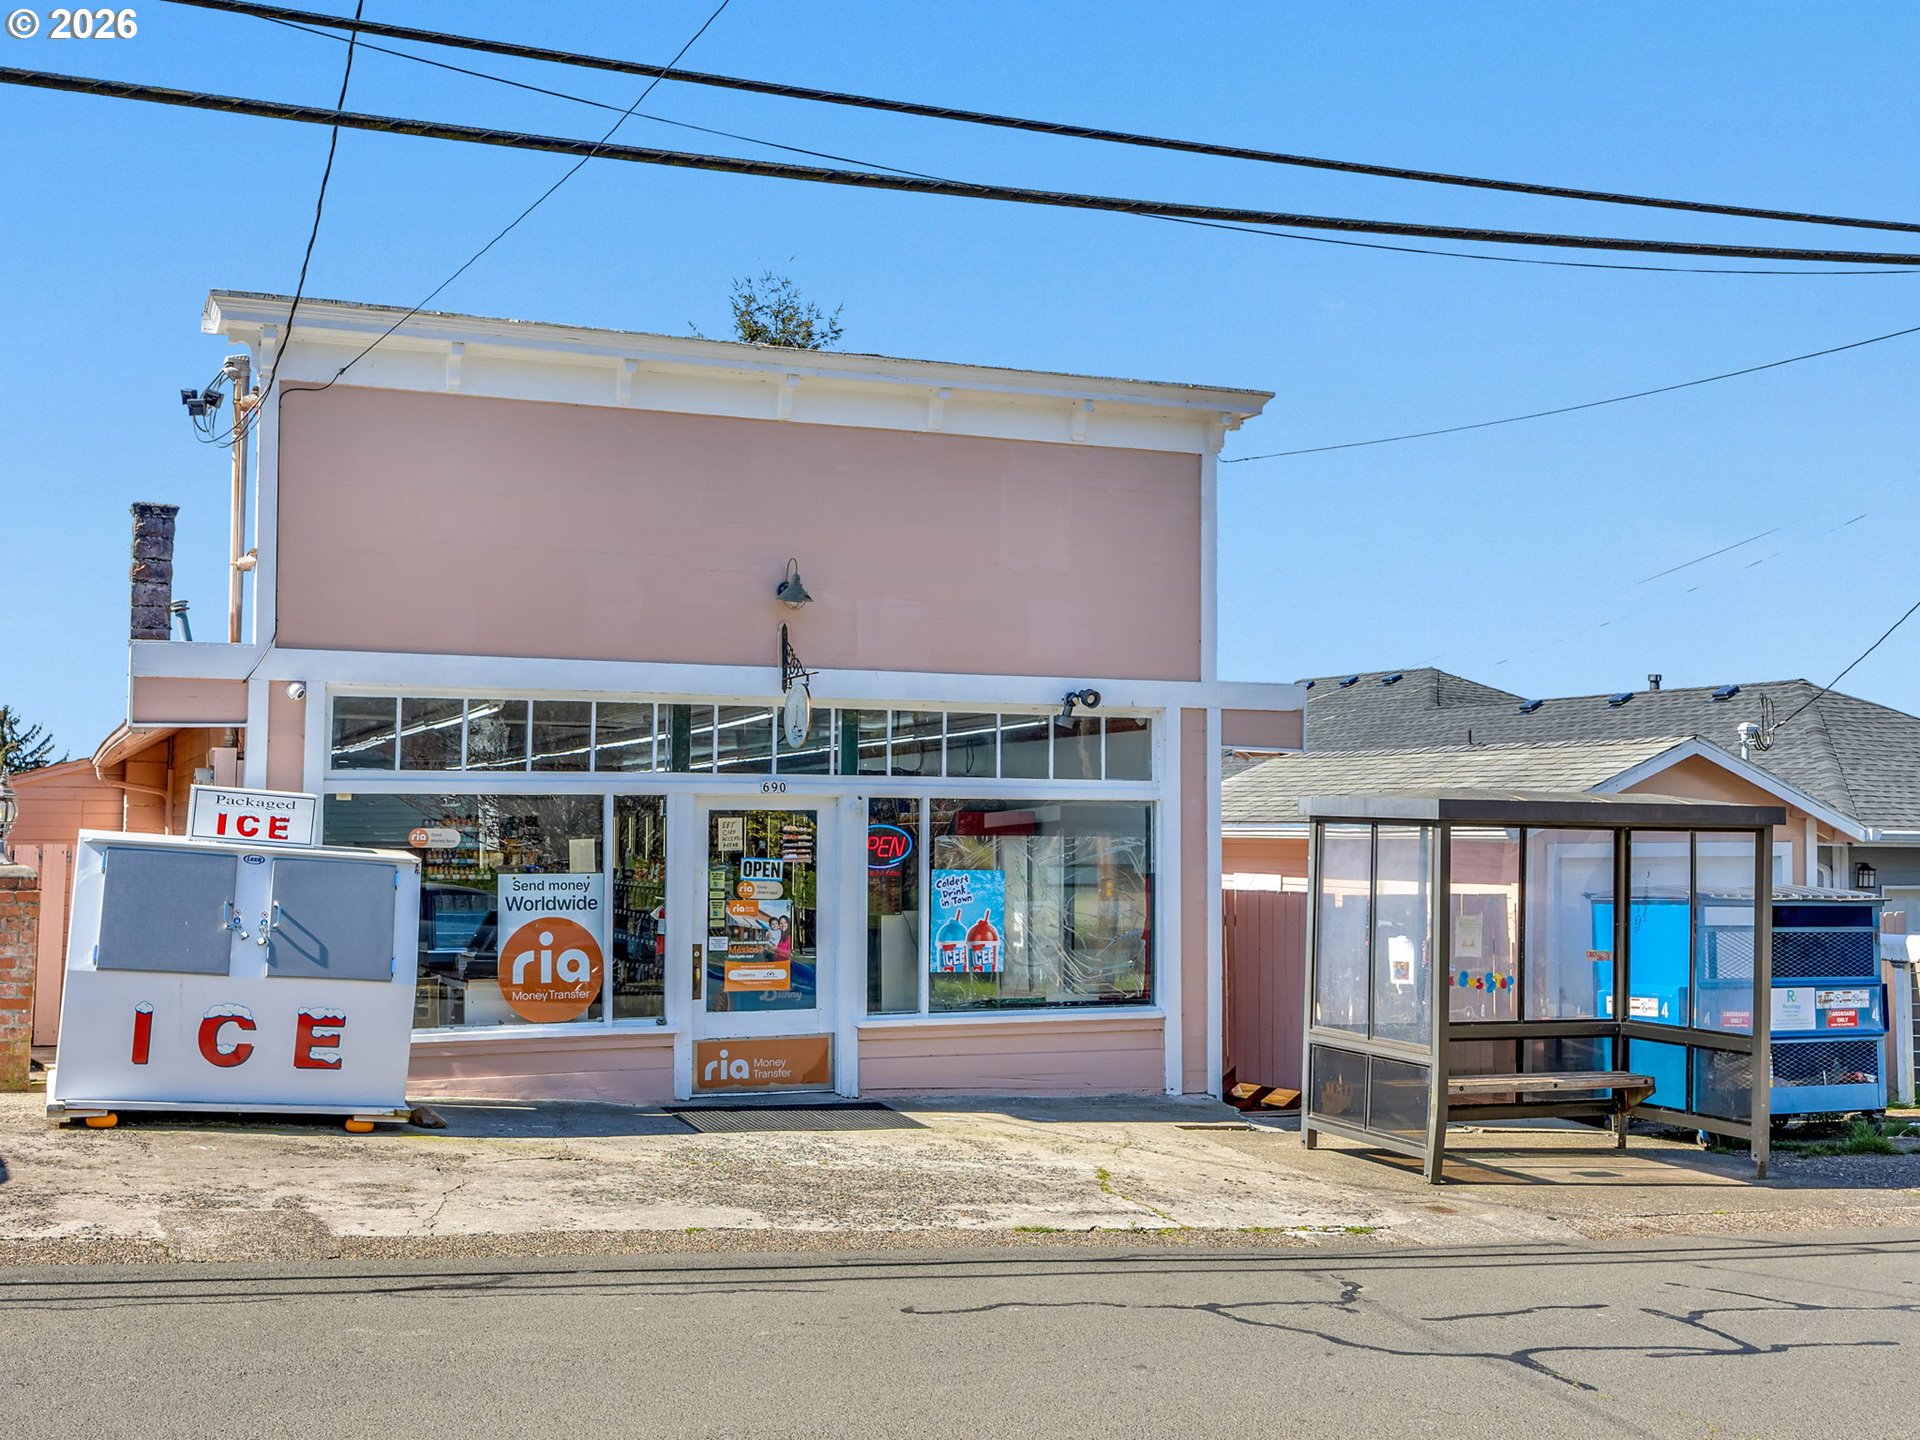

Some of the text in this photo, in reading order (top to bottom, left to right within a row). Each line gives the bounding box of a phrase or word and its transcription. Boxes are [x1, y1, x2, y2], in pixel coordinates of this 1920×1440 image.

[762, 782, 787, 793] 690
[216, 795, 296, 811] Packaged
[216, 809, 290, 840] ICE
[411, 830, 427, 841] ria
[867, 836, 907, 858] PEN
[743, 860, 781, 878] OPEN
[512, 880, 591, 893] Send money
[739, 883, 753, 893] ria
[936, 875, 969, 889] Coldest
[941, 892, 973, 907] in Town
[943, 885, 966, 898] Drink
[505, 894, 598, 912] Worldwide
[732, 903, 745, 913] ria
[512, 931, 591, 985] ria
[942, 949, 966, 966] ICEE
[971, 949, 994, 966] ICEE
[1459, 970, 1484, 990] Bus
[512, 989, 590, 1002] Money Transfer
[1661, 1002, 1669, 1019] 4
[1872, 1006, 1880, 1021] 4
[1704, 1011, 1711, 1027] 4
[132, 1000, 347, 1070] ICE
[704, 1049, 750, 1081] ria
[753, 1058, 787, 1068] Money
[753, 1069, 792, 1079] Transfer
